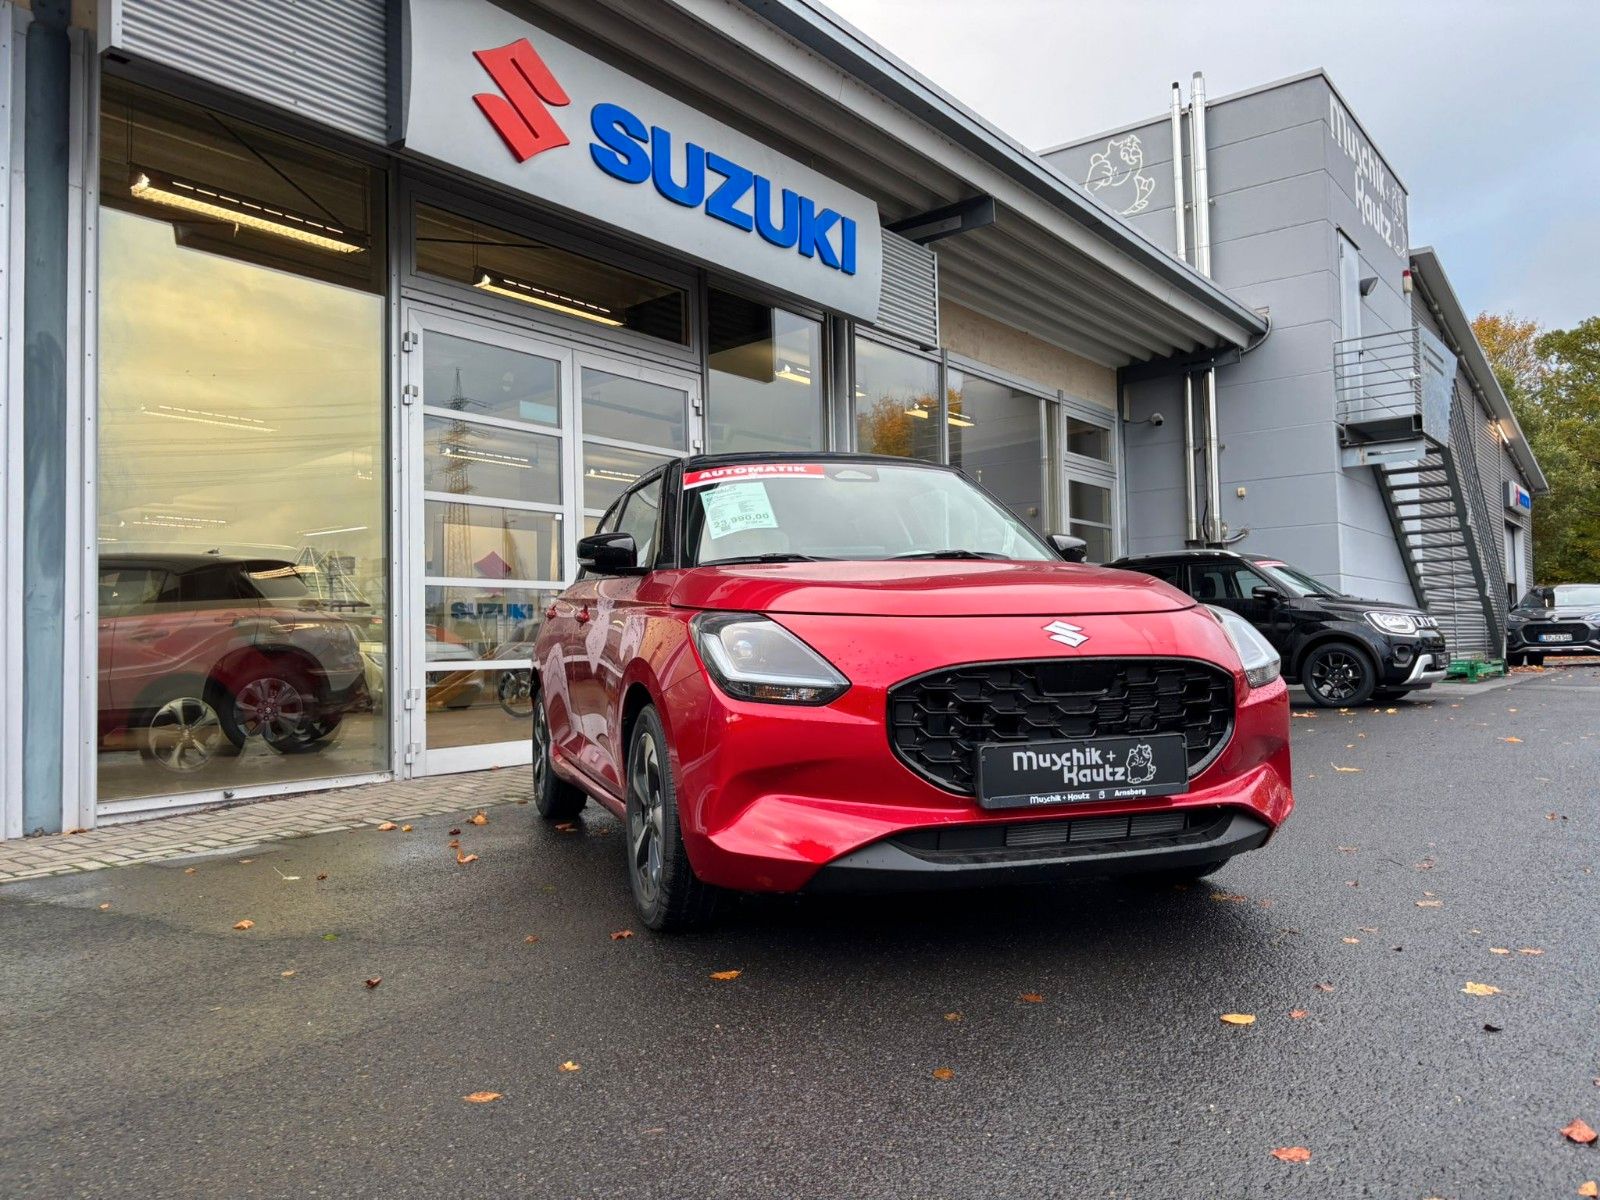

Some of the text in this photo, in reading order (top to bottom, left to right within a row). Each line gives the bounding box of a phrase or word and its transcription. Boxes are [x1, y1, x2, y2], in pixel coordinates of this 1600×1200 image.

[589, 103, 857, 275] SUZUKI
[699, 466, 806, 479] AUTOMATIK
[1063, 766, 1126, 786] Kautz
[1067, 792, 1090, 801] Kautz
[1114, 788, 1147, 797] Arnsberg
